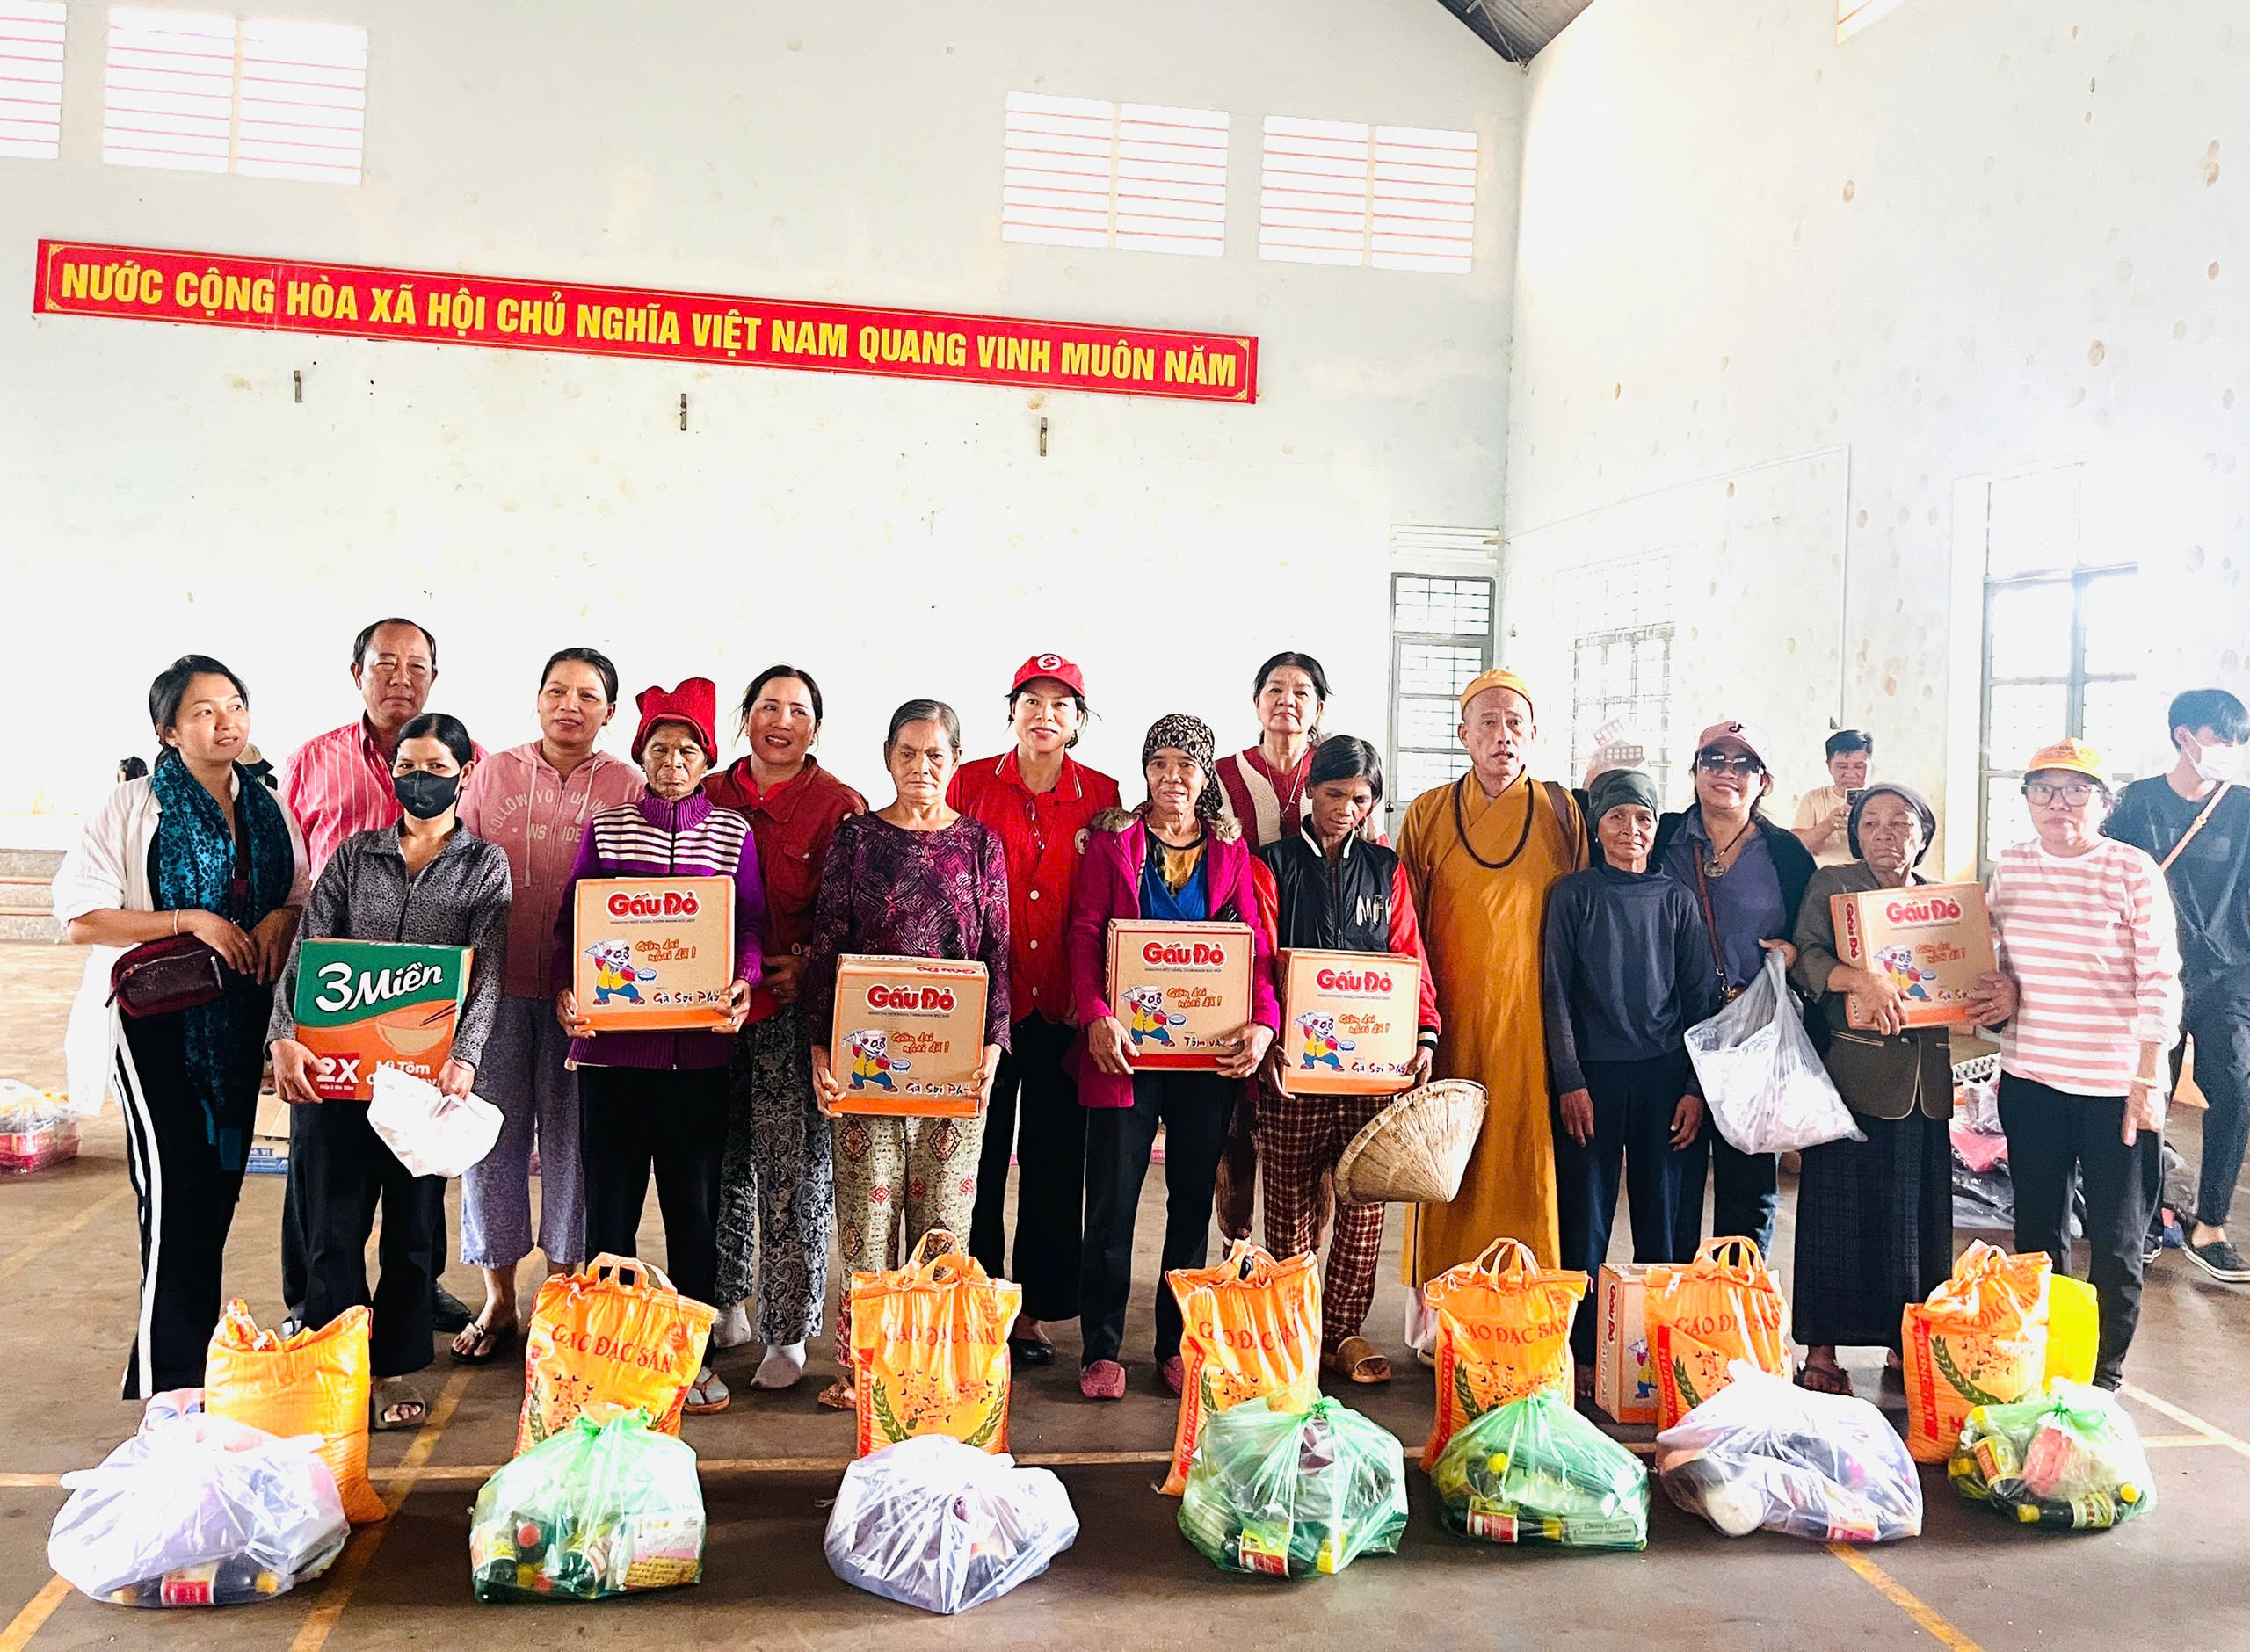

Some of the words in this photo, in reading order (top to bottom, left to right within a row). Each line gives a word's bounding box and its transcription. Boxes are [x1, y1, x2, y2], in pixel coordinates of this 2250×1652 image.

[63, 262, 162, 303] NƯỚC
[176, 267, 274, 315] CỘNG
[287, 276, 358, 321] HÒA
[369, 283, 416, 326] XÃ
[428, 287, 484, 338] HỘI
[497, 291, 565, 337] CHỦ
[577, 303, 680, 345] NGHĨA
[693, 308, 761, 357] VIỆT
[772, 320, 848, 358] NAM
[859, 325, 966, 367] QUANG
[977, 336, 1050, 374] VINH
[1062, 340, 1155, 381] MUÔN
[1165, 346, 1237, 388] NĂM
[490, 793, 528, 836] FOLLOW
[608, 893, 662, 916] Gấu
[663, 892, 700, 915] Đỏ
[1886, 901, 1930, 923] Gấu
[1931, 898, 1961, 920] Đỏ
[1143, 942, 1190, 965] Gấu
[1193, 943, 1224, 966] Đỏ
[349, 961, 442, 1010] Miền
[1317, 968, 1360, 991] Gấu
[1363, 971, 1393, 992] Đỏ
[653, 992, 669, 1004] Gà
[674, 991, 693, 1007] Sợi
[867, 985, 918, 1009] Gấu
[921, 988, 955, 1011] Đỏ
[1184, 1036, 1205, 1047] Tôm
[397, 1061, 430, 1074] Tôm
[1351, 1062, 1365, 1072] Gà
[905, 1083, 921, 1093] Gà
[925, 1083, 943, 1097] Sợi
